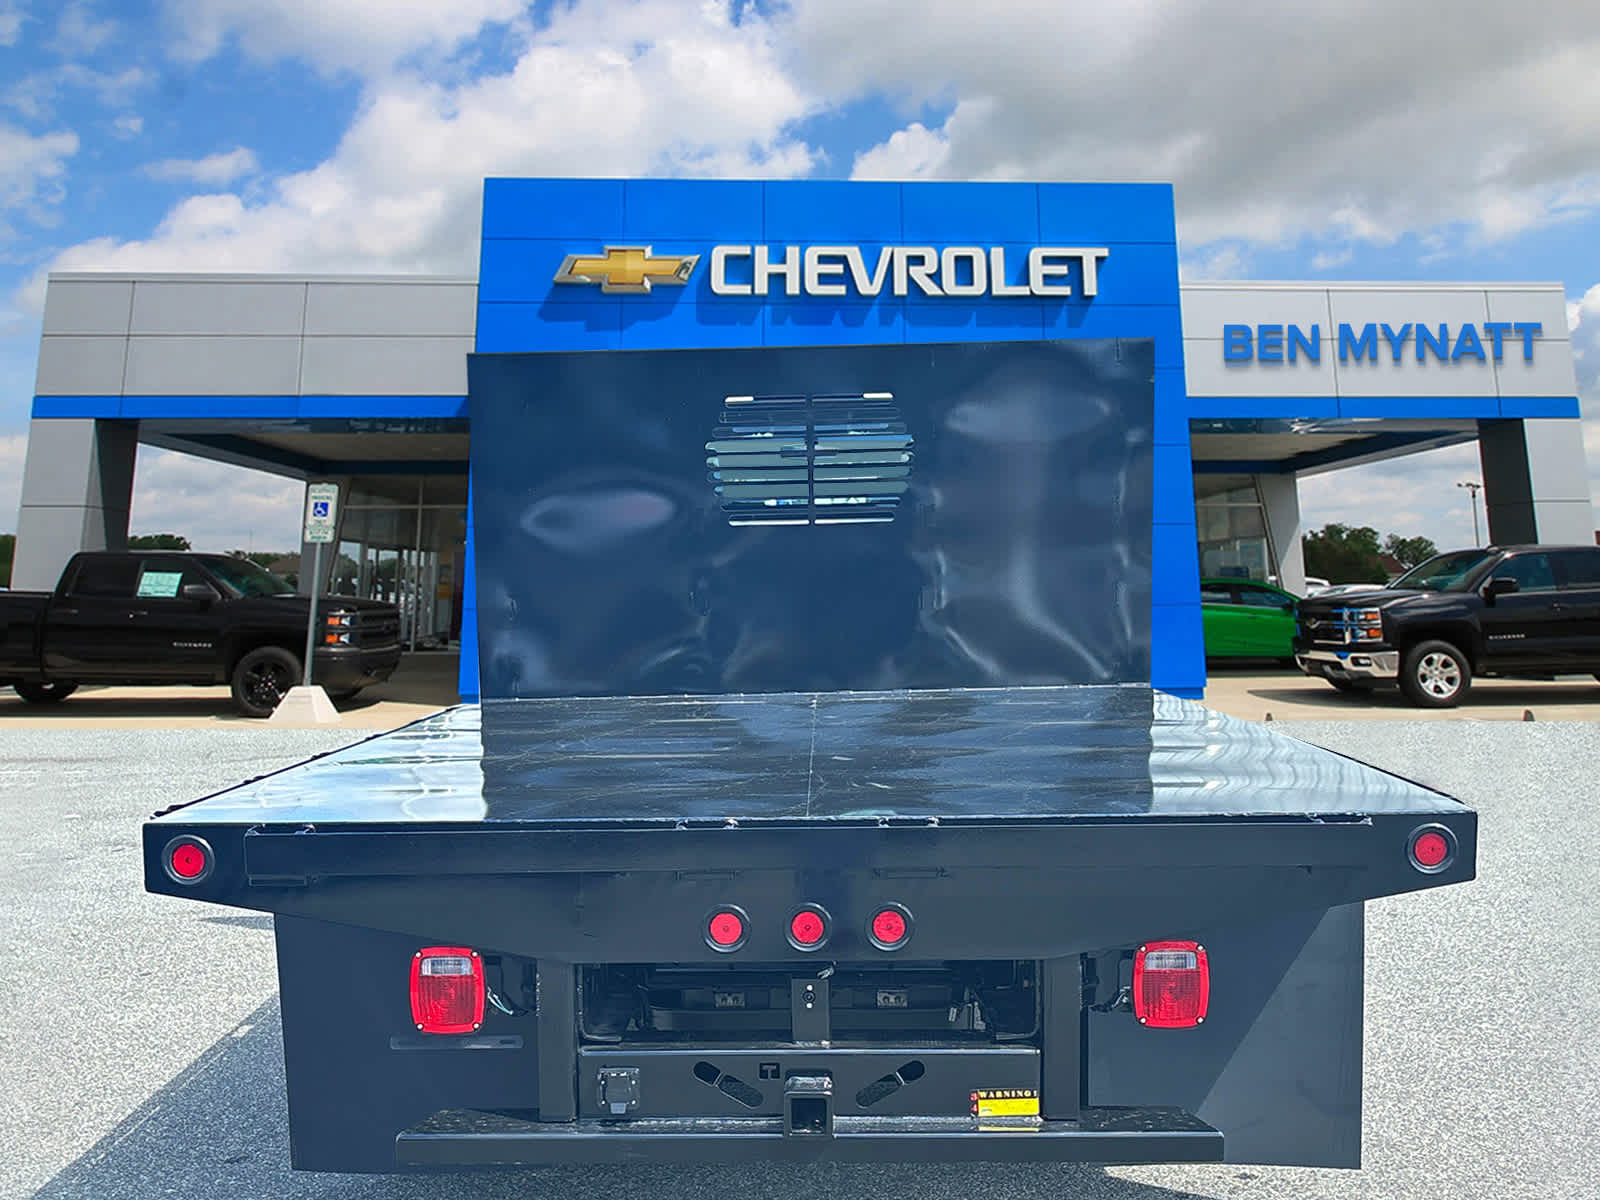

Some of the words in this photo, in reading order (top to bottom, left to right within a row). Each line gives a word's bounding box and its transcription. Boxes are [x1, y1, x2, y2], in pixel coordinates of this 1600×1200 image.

[710, 245, 1109, 297] CHEVROLET
[1223, 323, 1321, 362] BEN
[1338, 322, 1543, 362] MYNATT
[979, 1089, 1037, 1099] WARNING!
